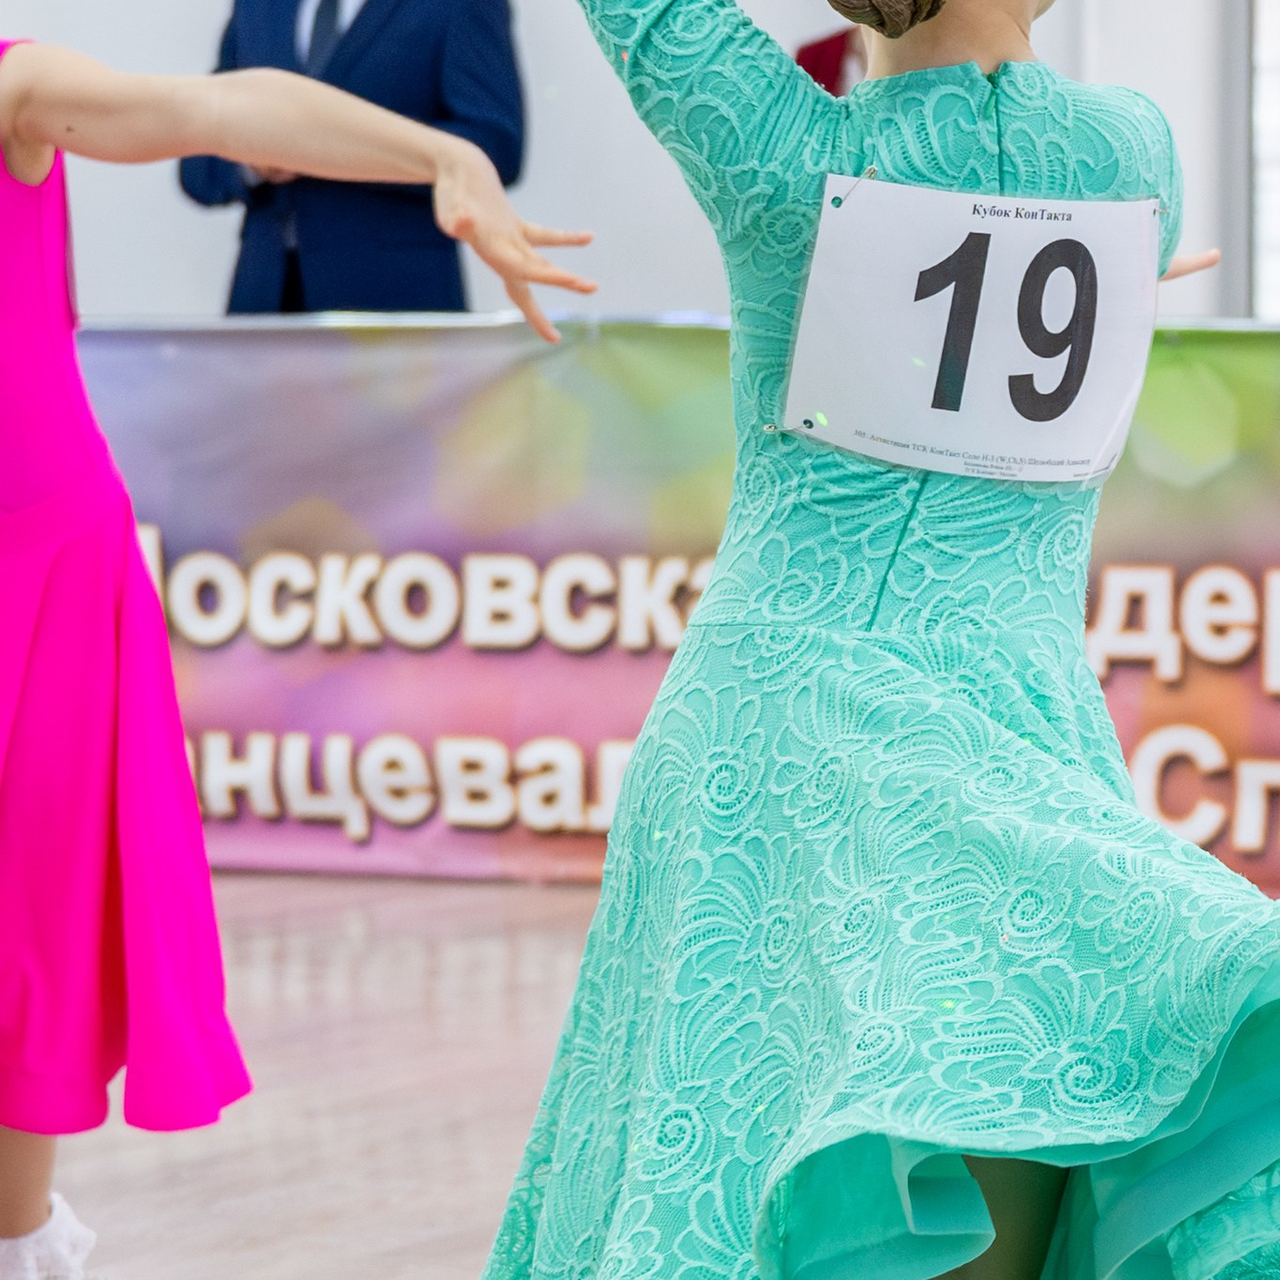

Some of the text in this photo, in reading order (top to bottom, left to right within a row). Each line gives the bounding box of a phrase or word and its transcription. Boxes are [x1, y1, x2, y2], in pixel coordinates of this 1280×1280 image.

[972, 203, 1073, 222] Кубок КонТакта
[914, 231, 1098, 422] 19
[187, 728, 634, 840] нцевал
